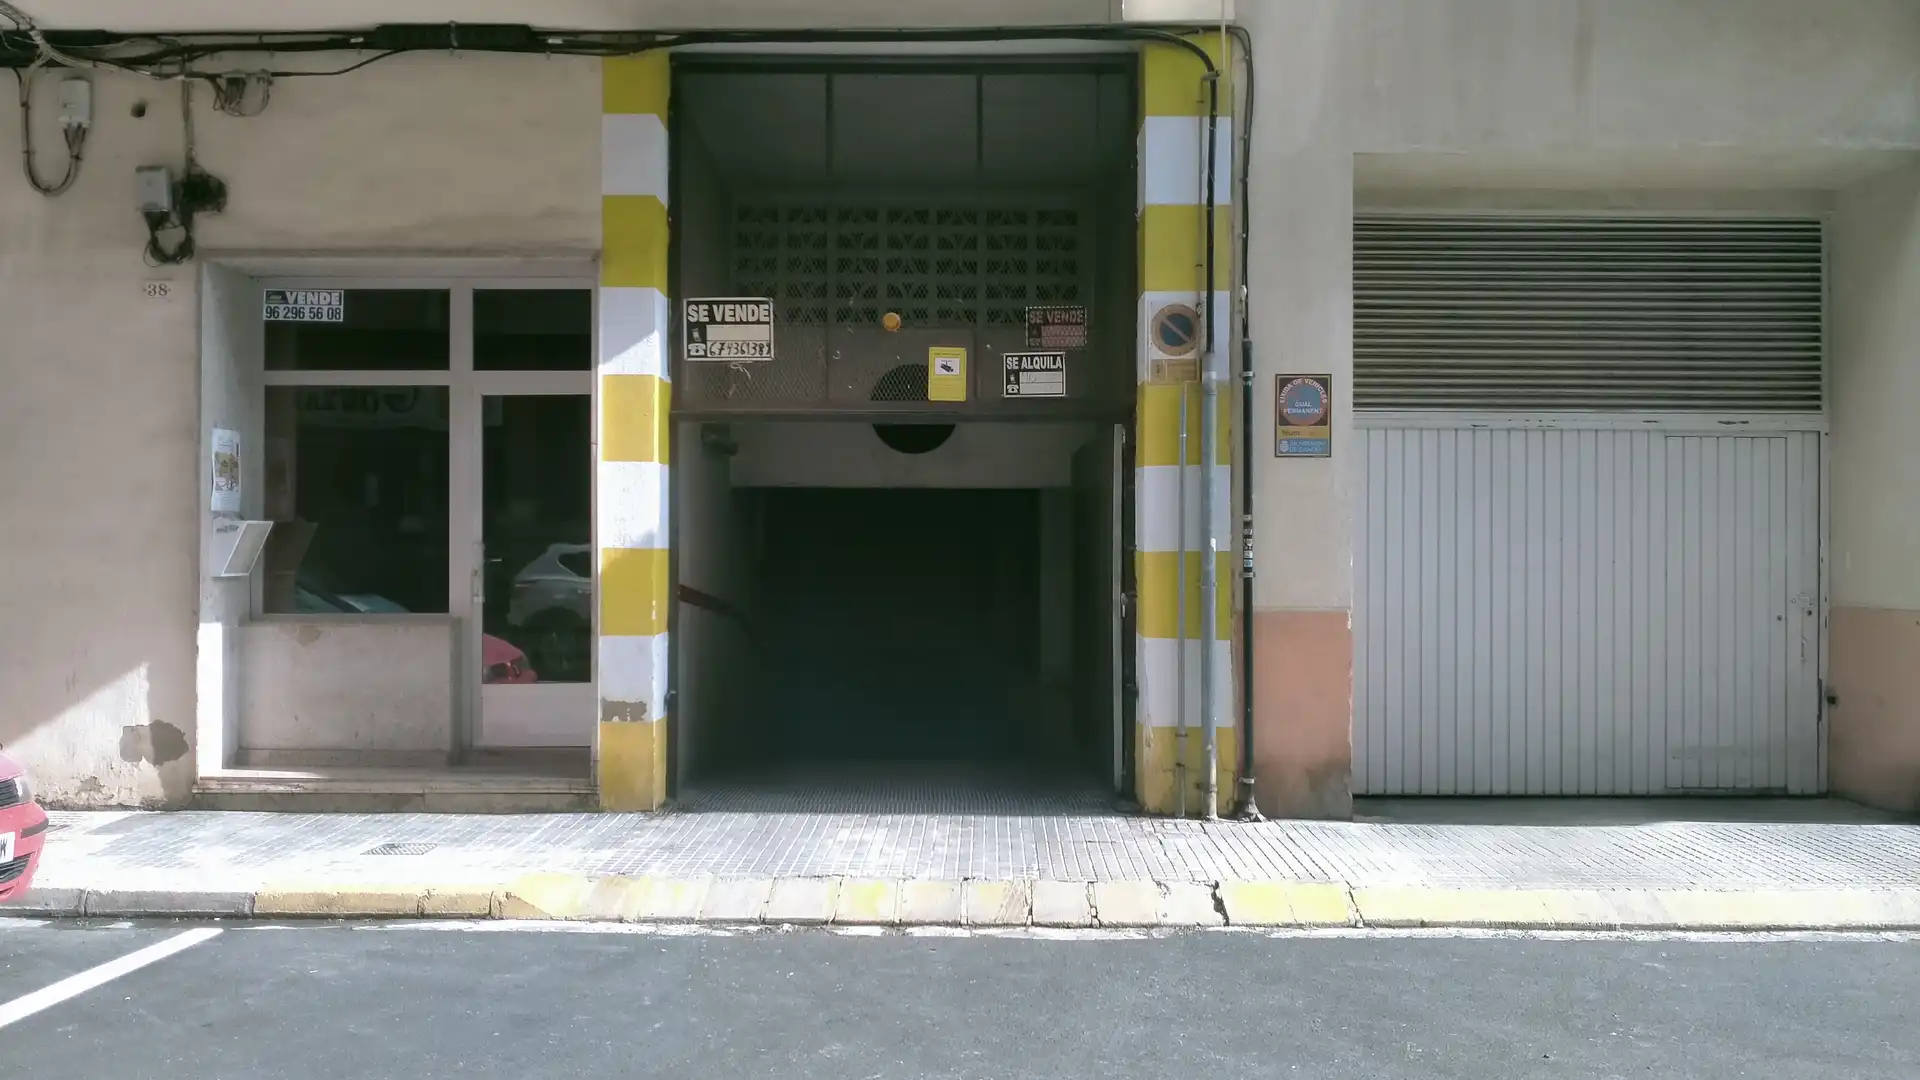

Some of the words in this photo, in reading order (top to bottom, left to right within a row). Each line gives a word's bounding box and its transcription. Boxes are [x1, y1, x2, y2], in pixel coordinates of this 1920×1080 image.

[285, 291, 340, 305] VENDE
[265, 306, 280, 319] 96
[283, 306, 306, 320] 296
[308, 307, 323, 320] 56
[326, 307, 342, 320] 08
[687, 304, 710, 322] SE
[712, 304, 770, 322] VENDE
[1029, 310, 1044, 324] SE
[1046, 310, 1084, 323] VENDE
[1006, 356, 1019, 370] SE
[1020, 356, 1063, 370] ALQUILA
[1304, 378, 1328, 404] VEHICLES
